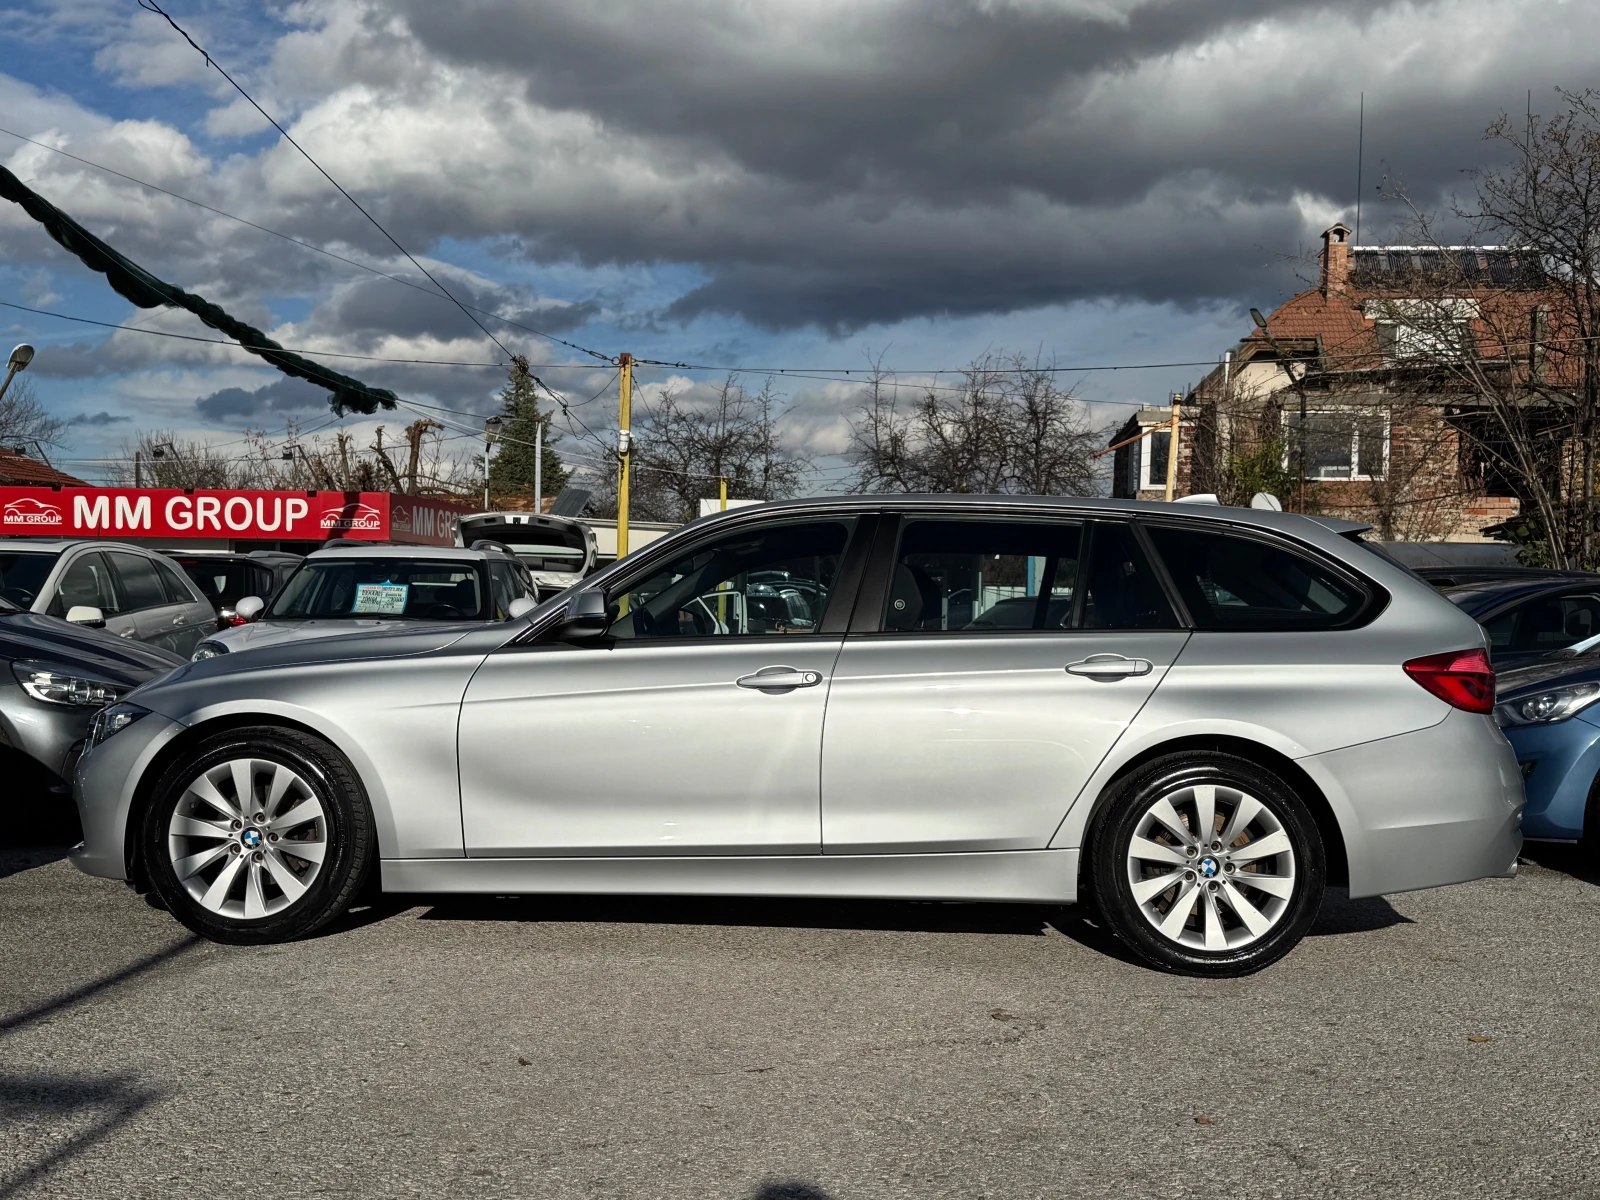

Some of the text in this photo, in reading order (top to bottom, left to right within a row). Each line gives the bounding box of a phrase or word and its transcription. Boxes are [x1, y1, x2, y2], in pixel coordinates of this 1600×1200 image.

[4, 515, 62, 523] MM GROUP
[74, 495, 309, 532] MM GROUP
[320, 519, 380, 528] MM GROUP
[413, 505, 435, 537] MM
